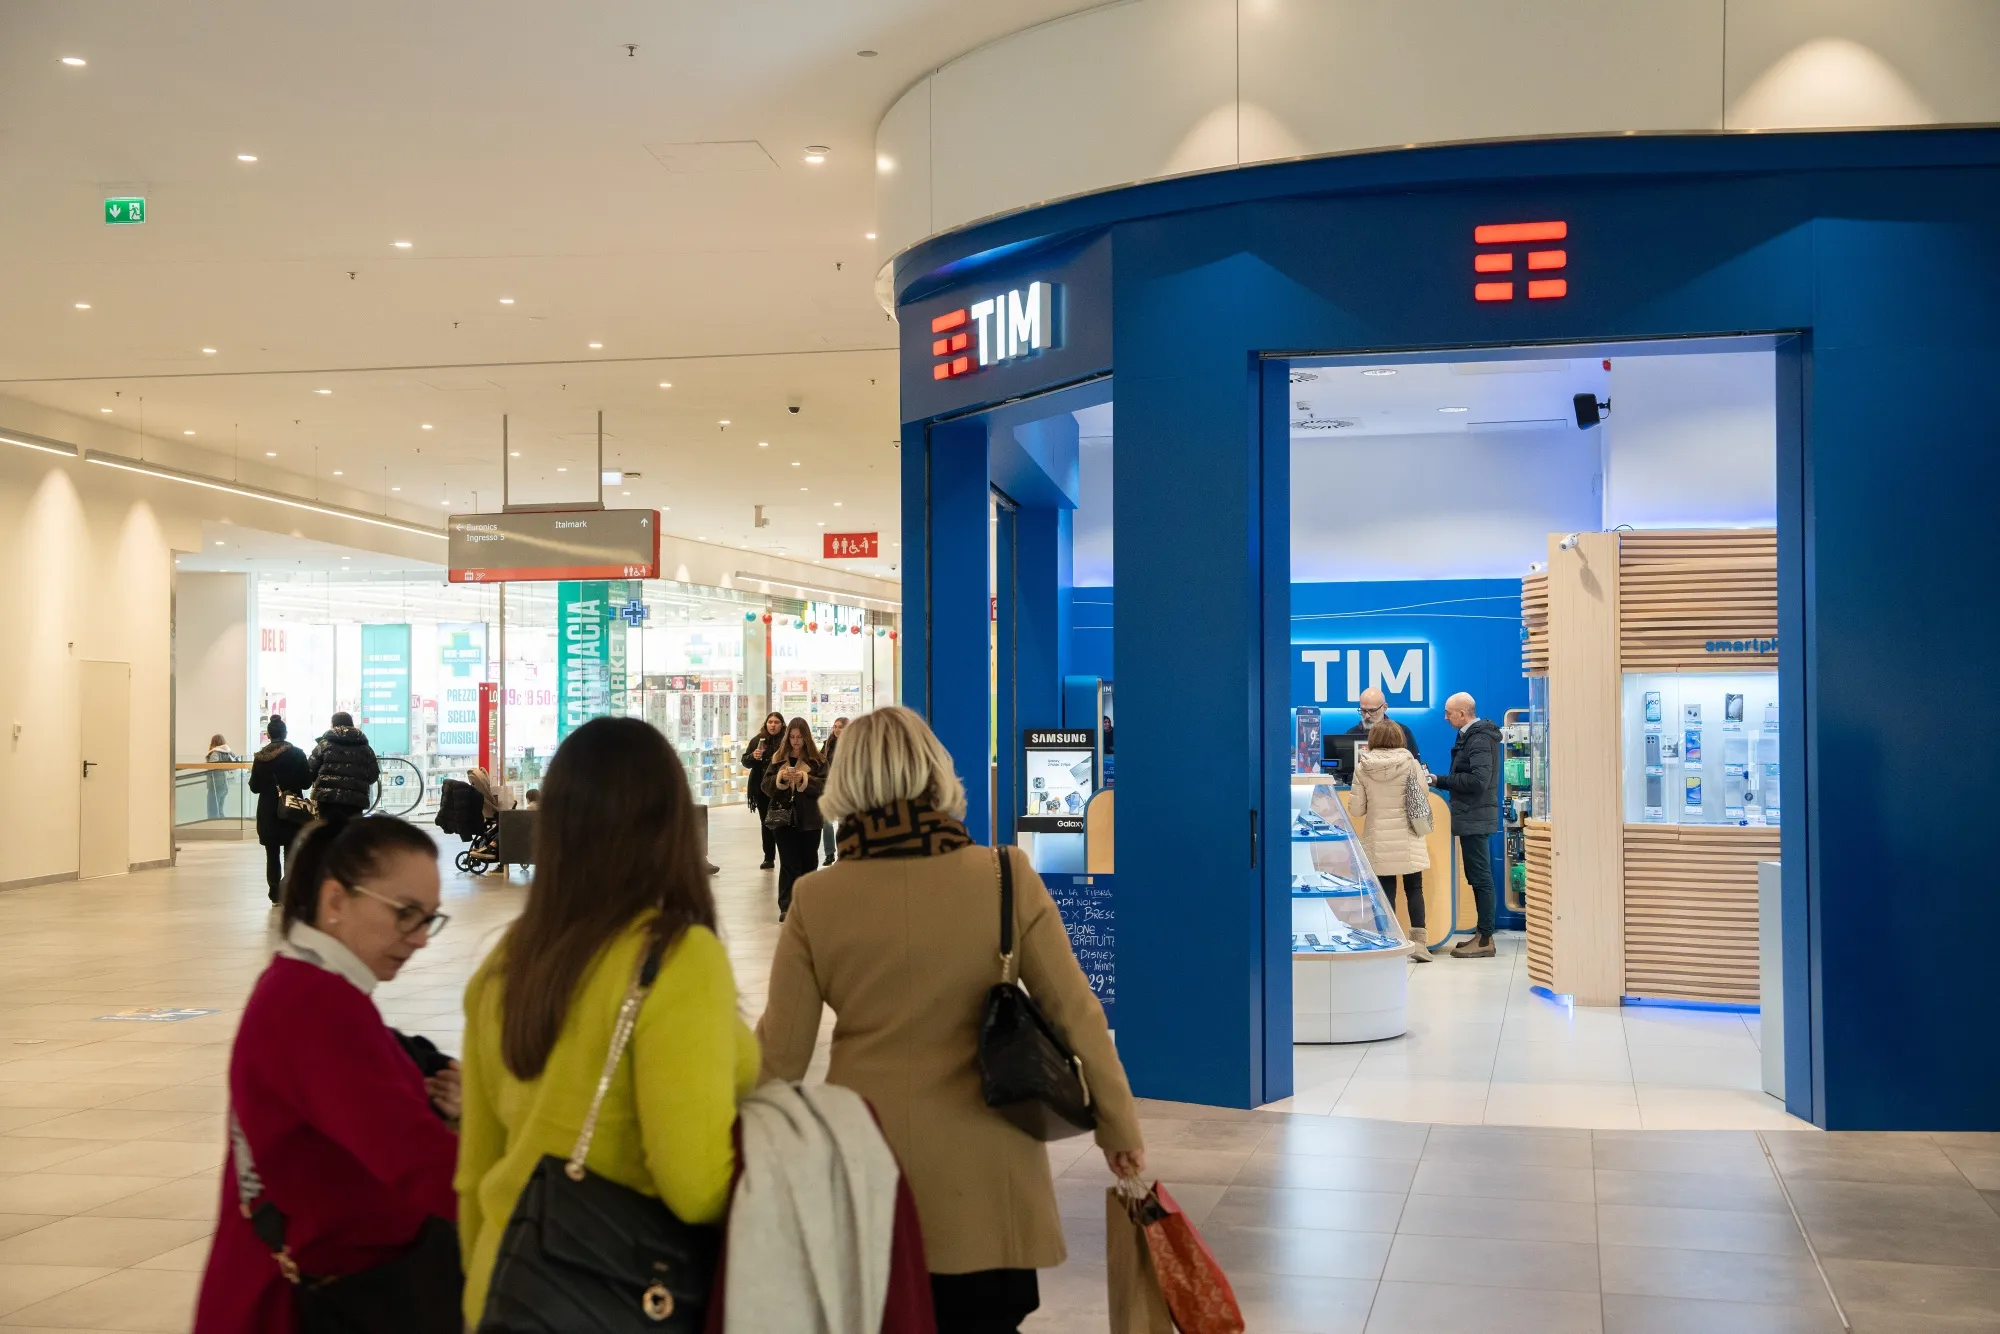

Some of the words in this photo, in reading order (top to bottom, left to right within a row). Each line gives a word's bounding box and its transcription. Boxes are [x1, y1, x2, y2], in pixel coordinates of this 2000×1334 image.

[971, 281, 1046, 366] TIM
[466, 523, 498, 531] Euronics
[555, 520, 588, 529] Italmark
[466, 534, 498, 543] Ingresso
[500, 533, 505, 541] 5
[566, 599, 601, 736] FARMACIA
[1301, 648, 1423, 702] TIM
[447, 688, 477, 702] PREZZO
[447, 709, 477, 724] SCELTA
[1031, 733, 1087, 743] SAMSUNG
[1057, 820, 1085, 829] Galaxy
